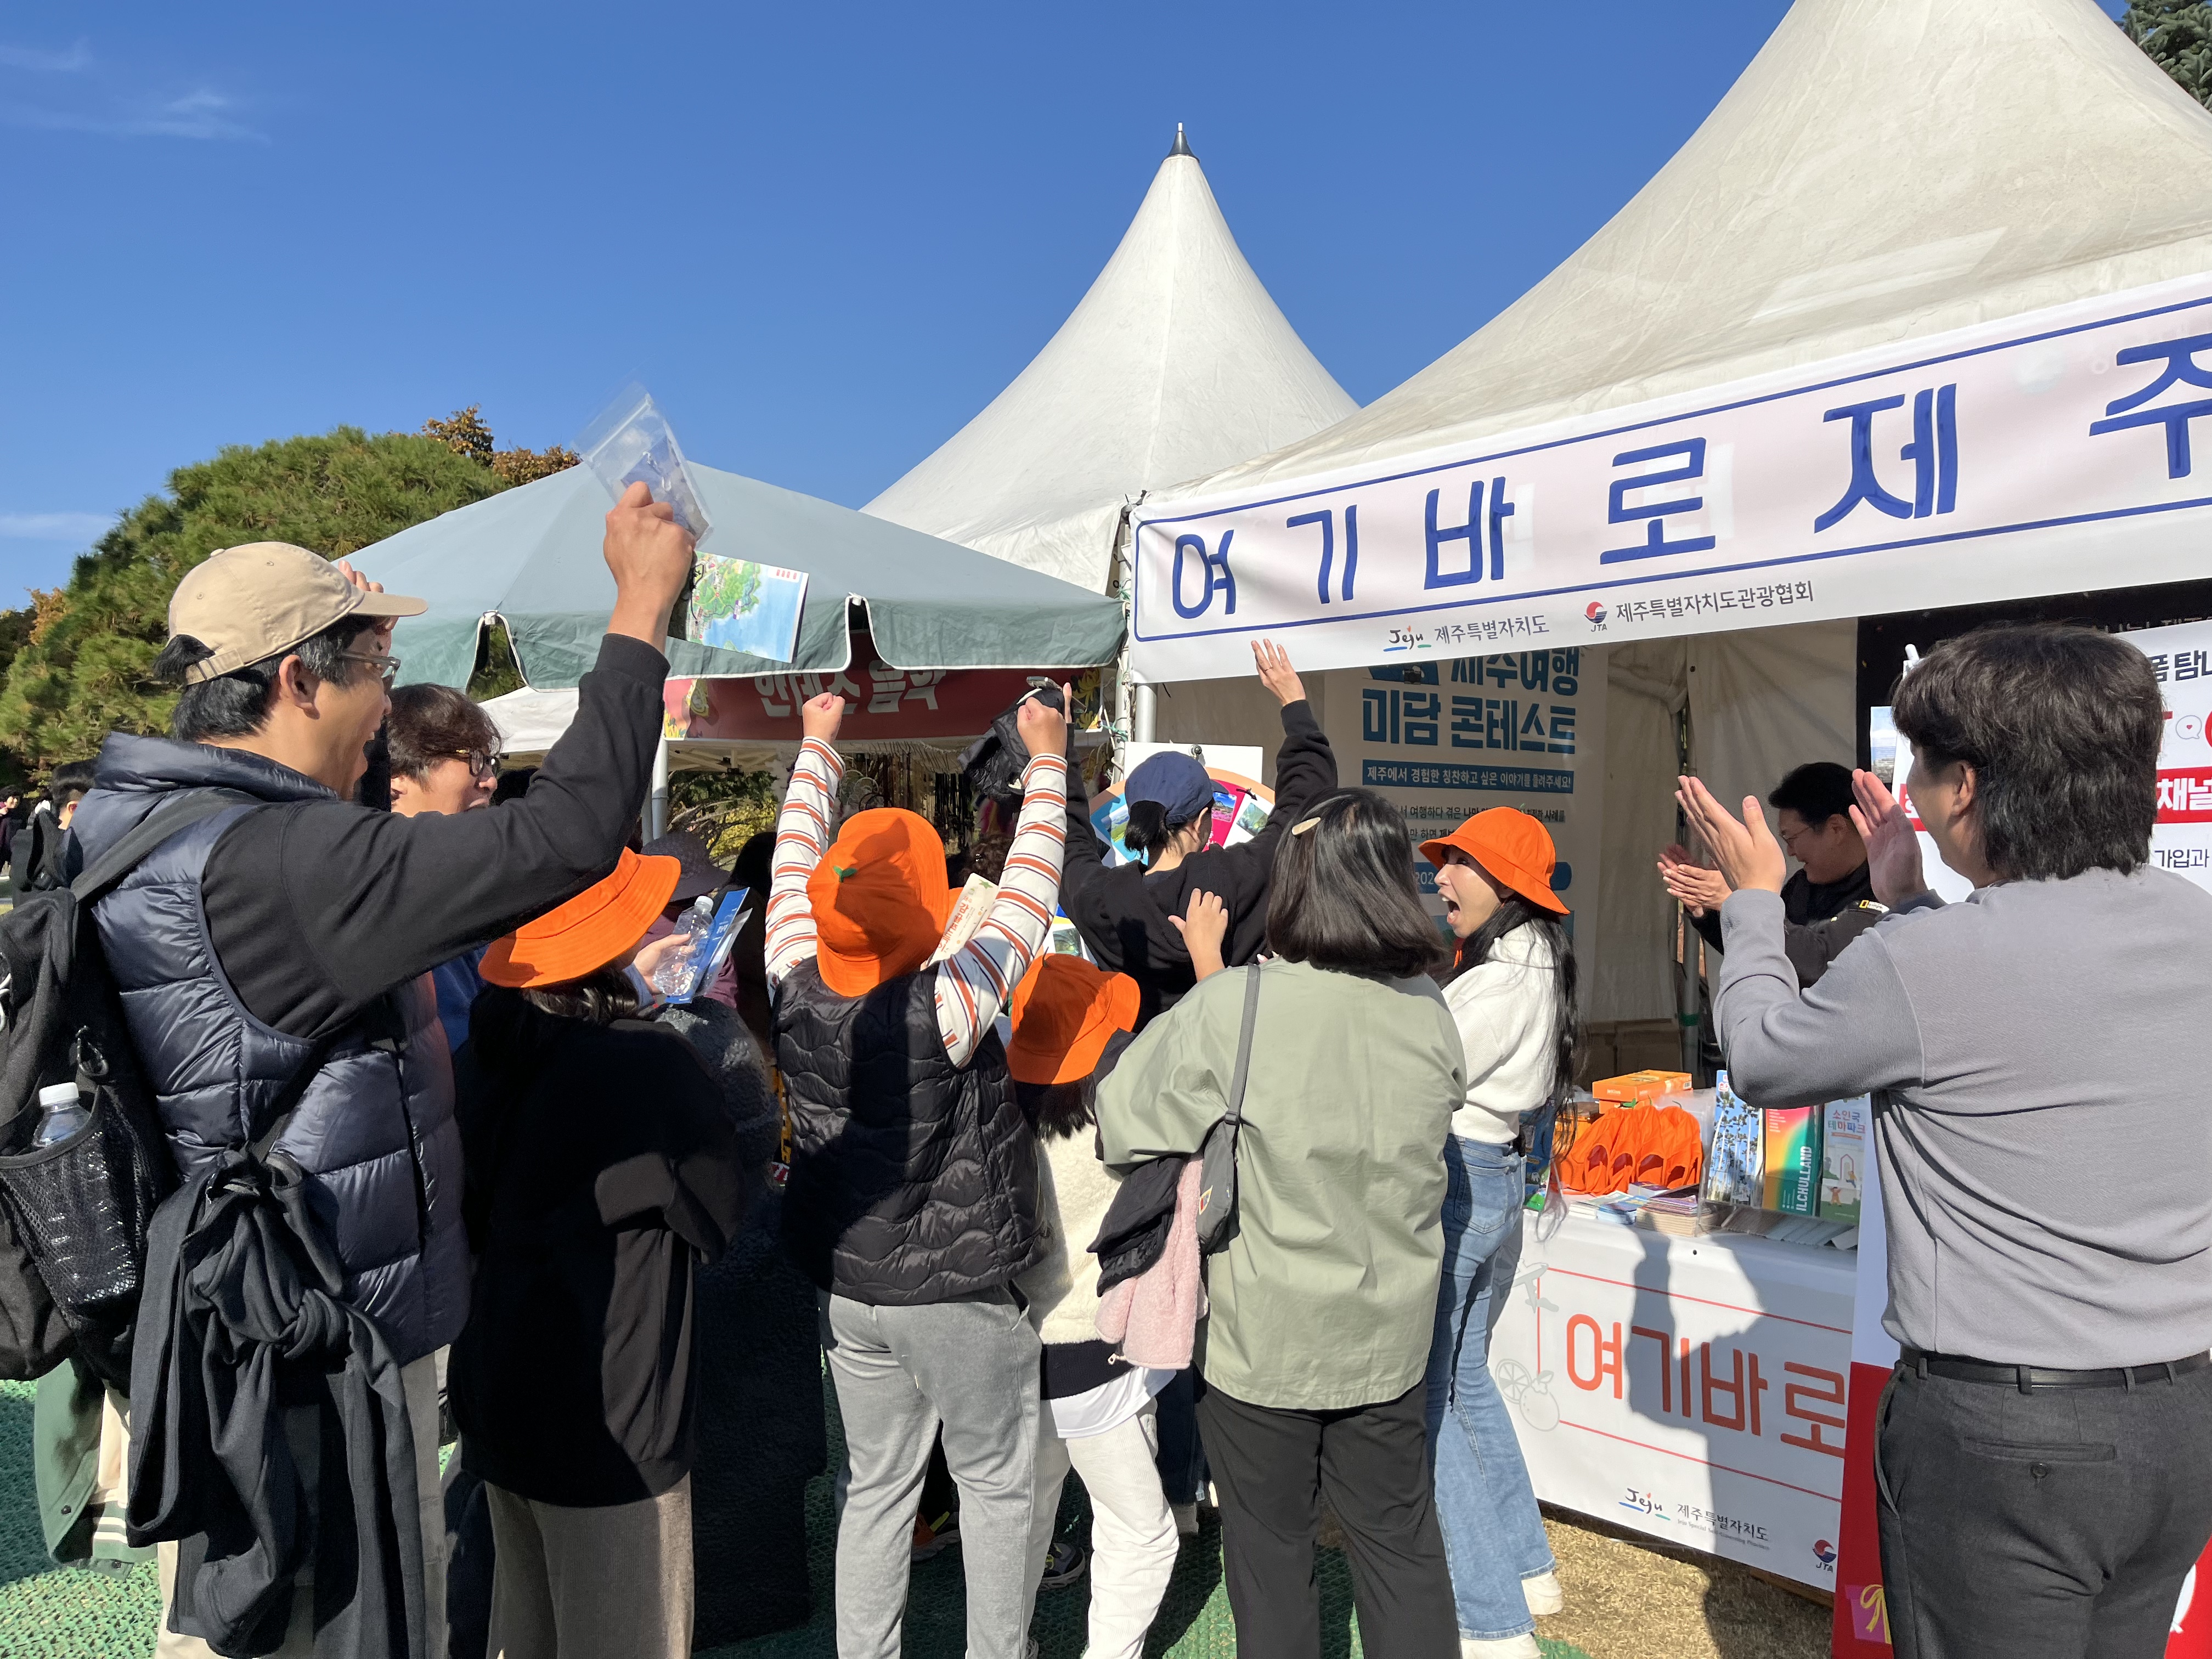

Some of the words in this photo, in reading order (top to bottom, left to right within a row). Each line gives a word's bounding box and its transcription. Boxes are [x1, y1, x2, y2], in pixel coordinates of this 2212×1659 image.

[1616, 580, 1814, 623] 제주특별자치도관광협회
[1389, 625, 1424, 650] Jeju
[1434, 615, 1549, 645] 제주특별자치도
[1590, 623, 1607, 633] JTA
[1362, 689, 1441, 746] 미담
[1451, 695, 1576, 754] 콘테스트
[1367, 766, 1408, 782] 제주에서
[1410, 768, 1440, 784] 경험한
[1442, 769, 1479, 785] 칭찬하고
[1481, 771, 1498, 786] 싶은
[1410, 806, 1444, 820] 여행하다
[1446, 806, 1461, 820] 겪은
[1828, 1120, 1866, 1134] 테마파크
[1832, 1109, 1861, 1121] 소인국
[1796, 1146, 1812, 1212] ILCHULLAND
[1624, 1487, 1663, 1514] Jeju
[1677, 1503, 1769, 1542] 제주특별자치도
[1815, 1561, 1834, 1573] JTA
